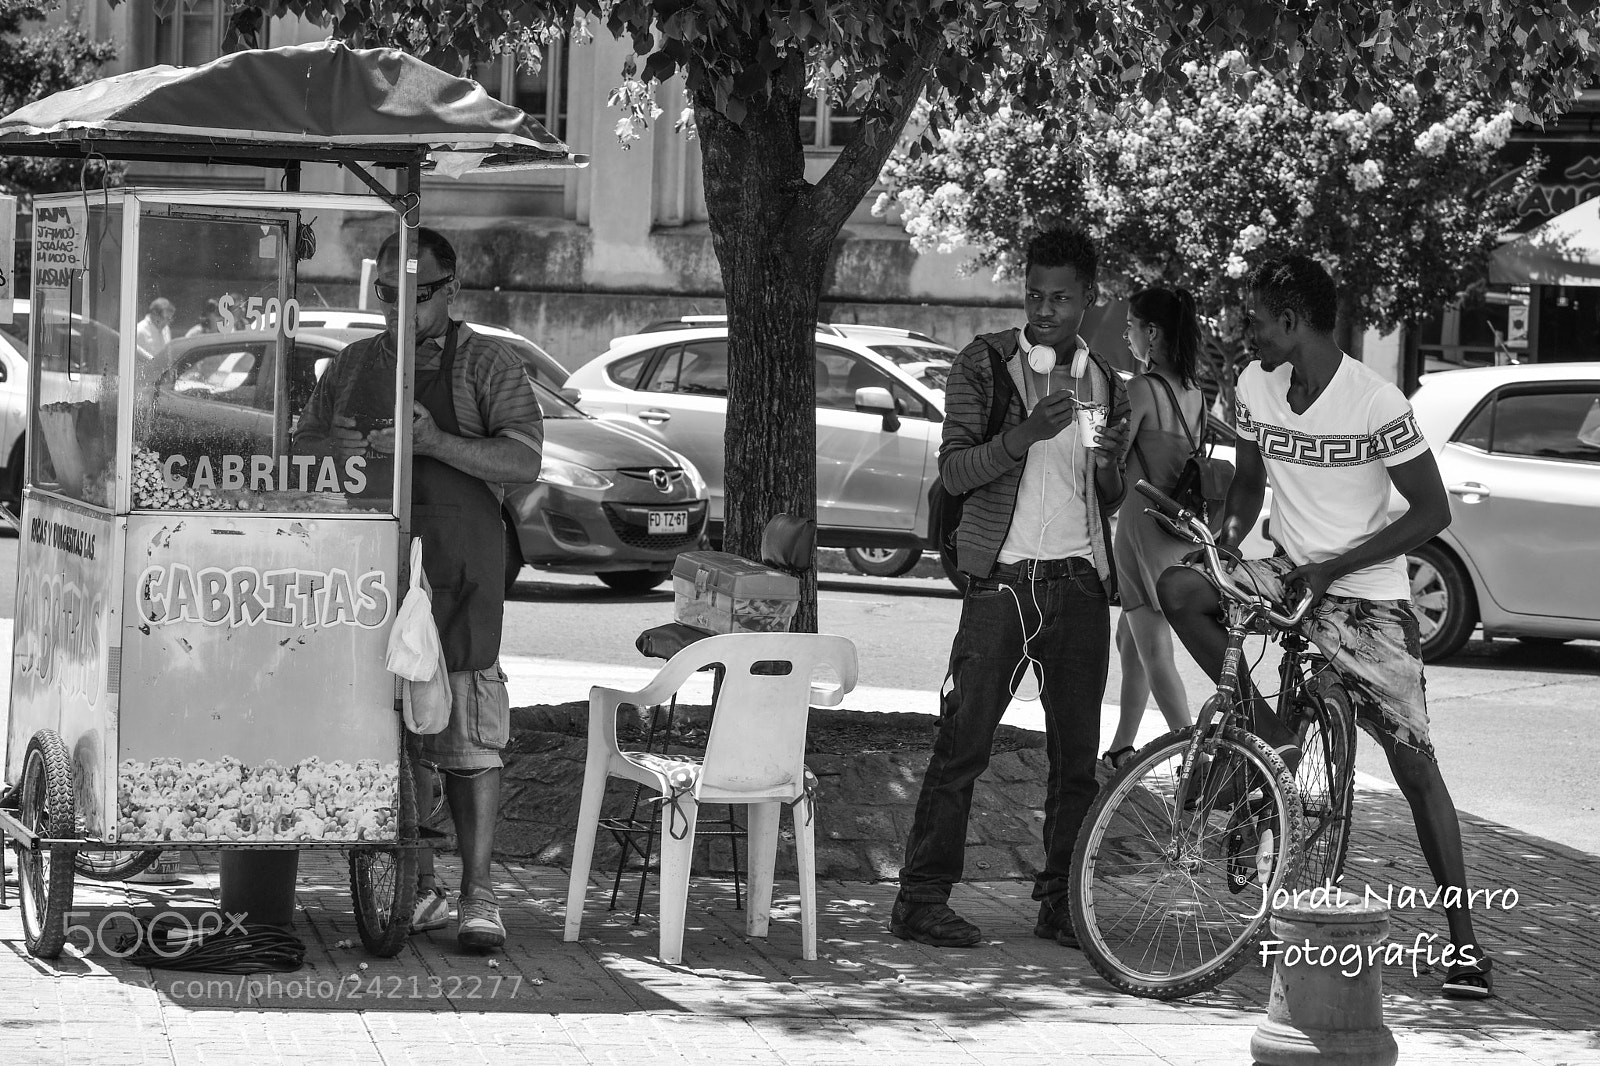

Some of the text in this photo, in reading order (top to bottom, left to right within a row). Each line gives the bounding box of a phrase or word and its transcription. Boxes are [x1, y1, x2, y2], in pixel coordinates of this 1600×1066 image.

[246, 296, 300, 339] 500
[163, 454, 367, 494] CABRITAS
[136, 563, 391, 630] CABRITAS
